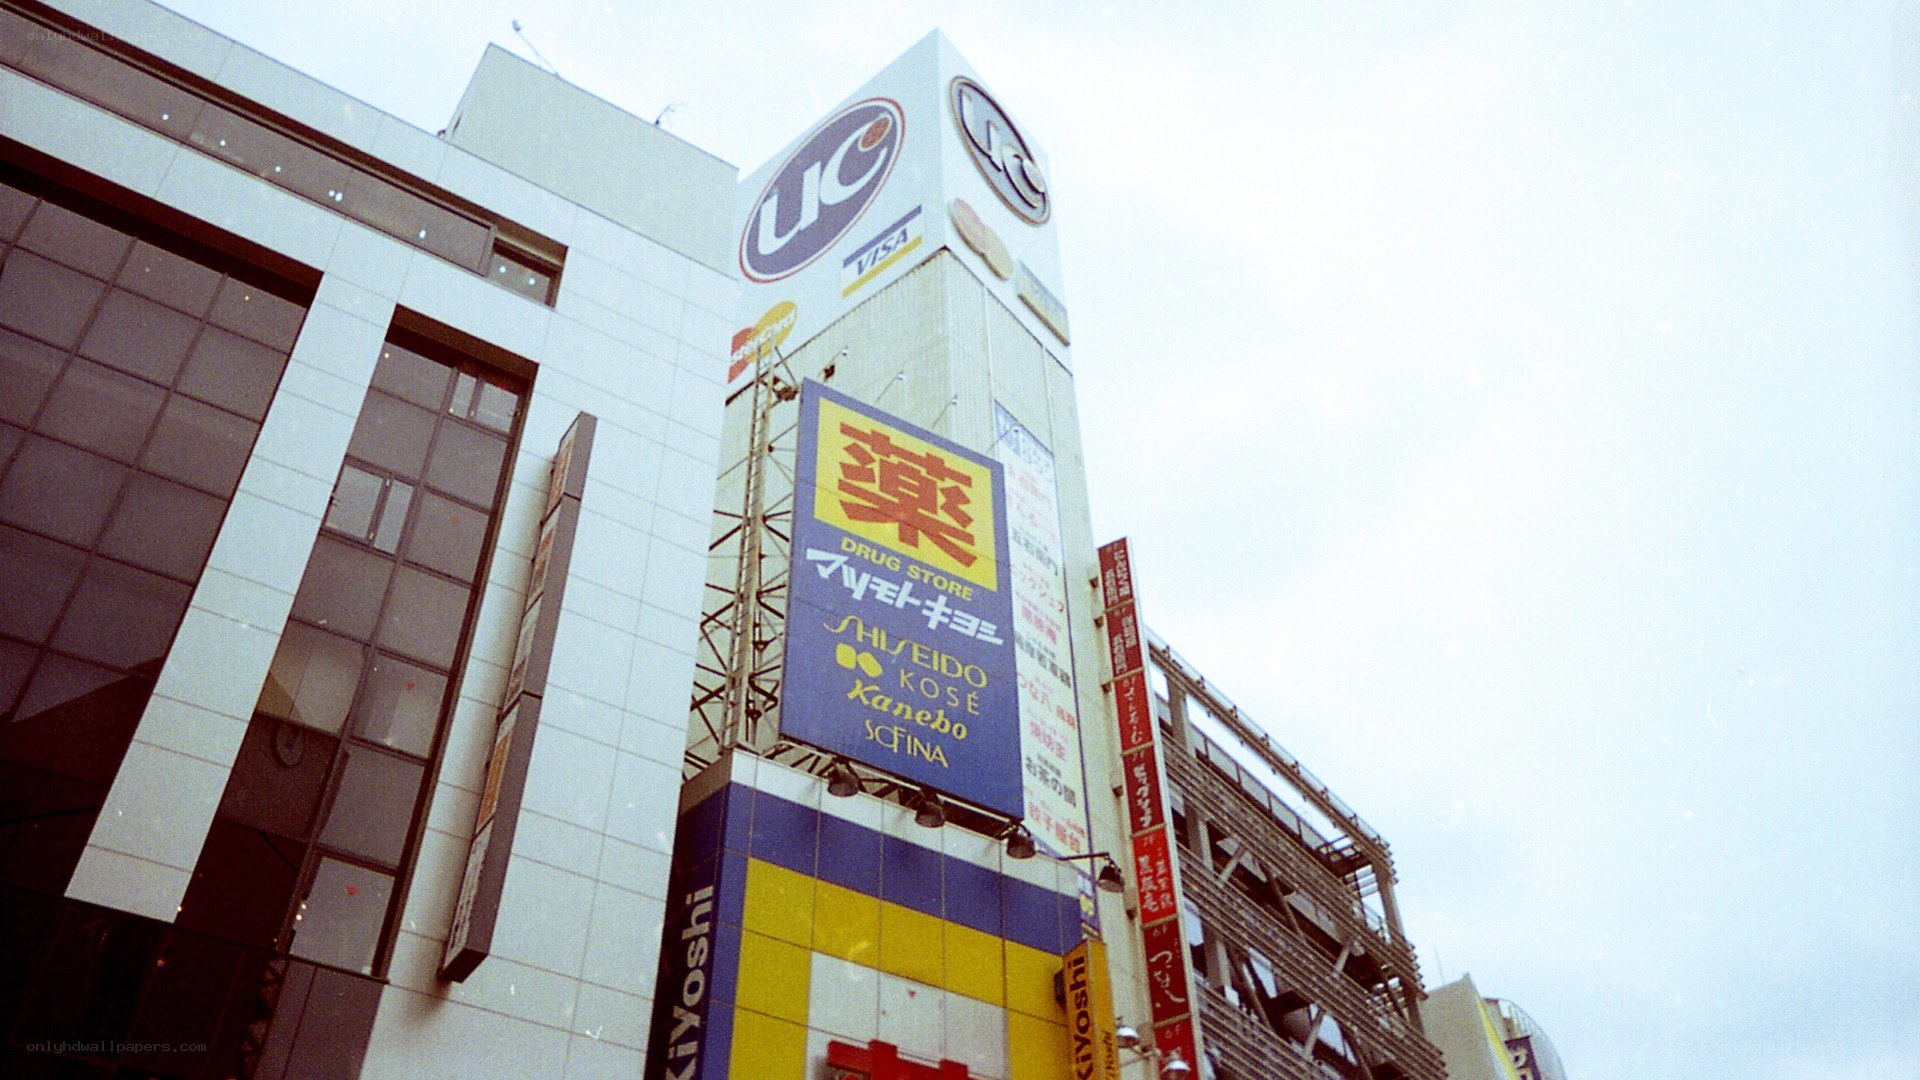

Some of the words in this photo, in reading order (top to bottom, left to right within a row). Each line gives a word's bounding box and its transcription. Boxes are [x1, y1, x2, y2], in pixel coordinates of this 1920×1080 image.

[757, 112, 890, 257] UC
[857, 227, 908, 276] VISA
[838, 421, 978, 568] 薬
[806, 548, 1004, 645] マツモトキヨシ
[841, 537, 901, 572] DRUG
[907, 565, 974, 601] STORE
[823, 615, 987, 689] SHISEIDO
[847, 679, 968, 740] Kanebo
[900, 669, 980, 716] KOSÉ
